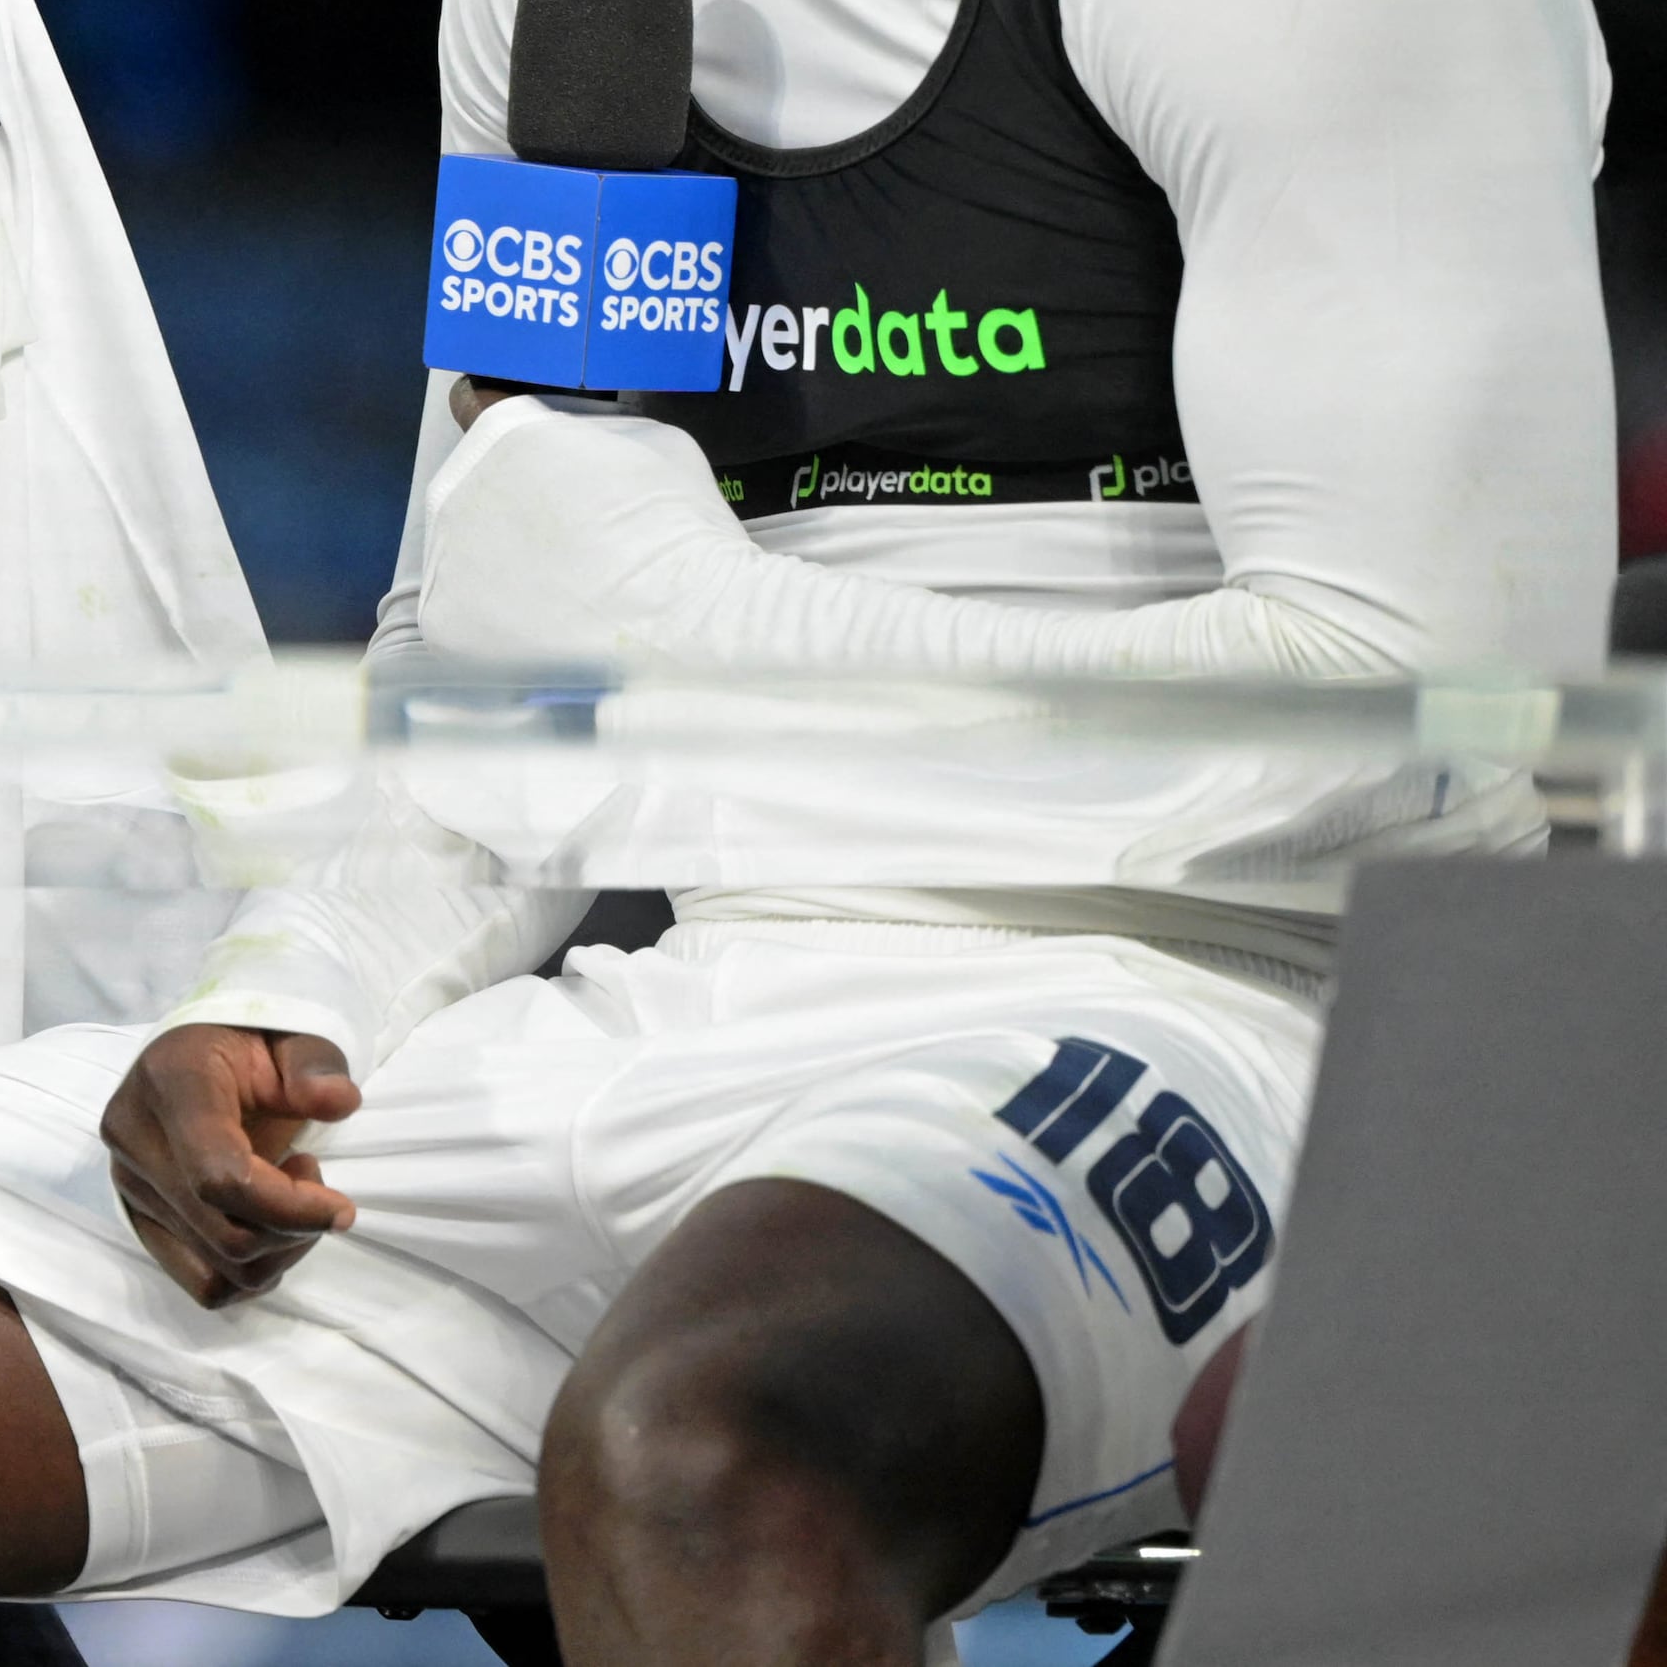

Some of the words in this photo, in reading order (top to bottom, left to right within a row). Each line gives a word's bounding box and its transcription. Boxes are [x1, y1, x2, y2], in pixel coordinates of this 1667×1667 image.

[485, 226, 582, 285] CBS
[640, 240, 724, 292] CBS
[440, 275, 579, 327] SPORTS
[600, 295, 720, 333] SPORTS
[820, 463, 993, 501] playerdata
[993, 1036, 1276, 1348] 18
